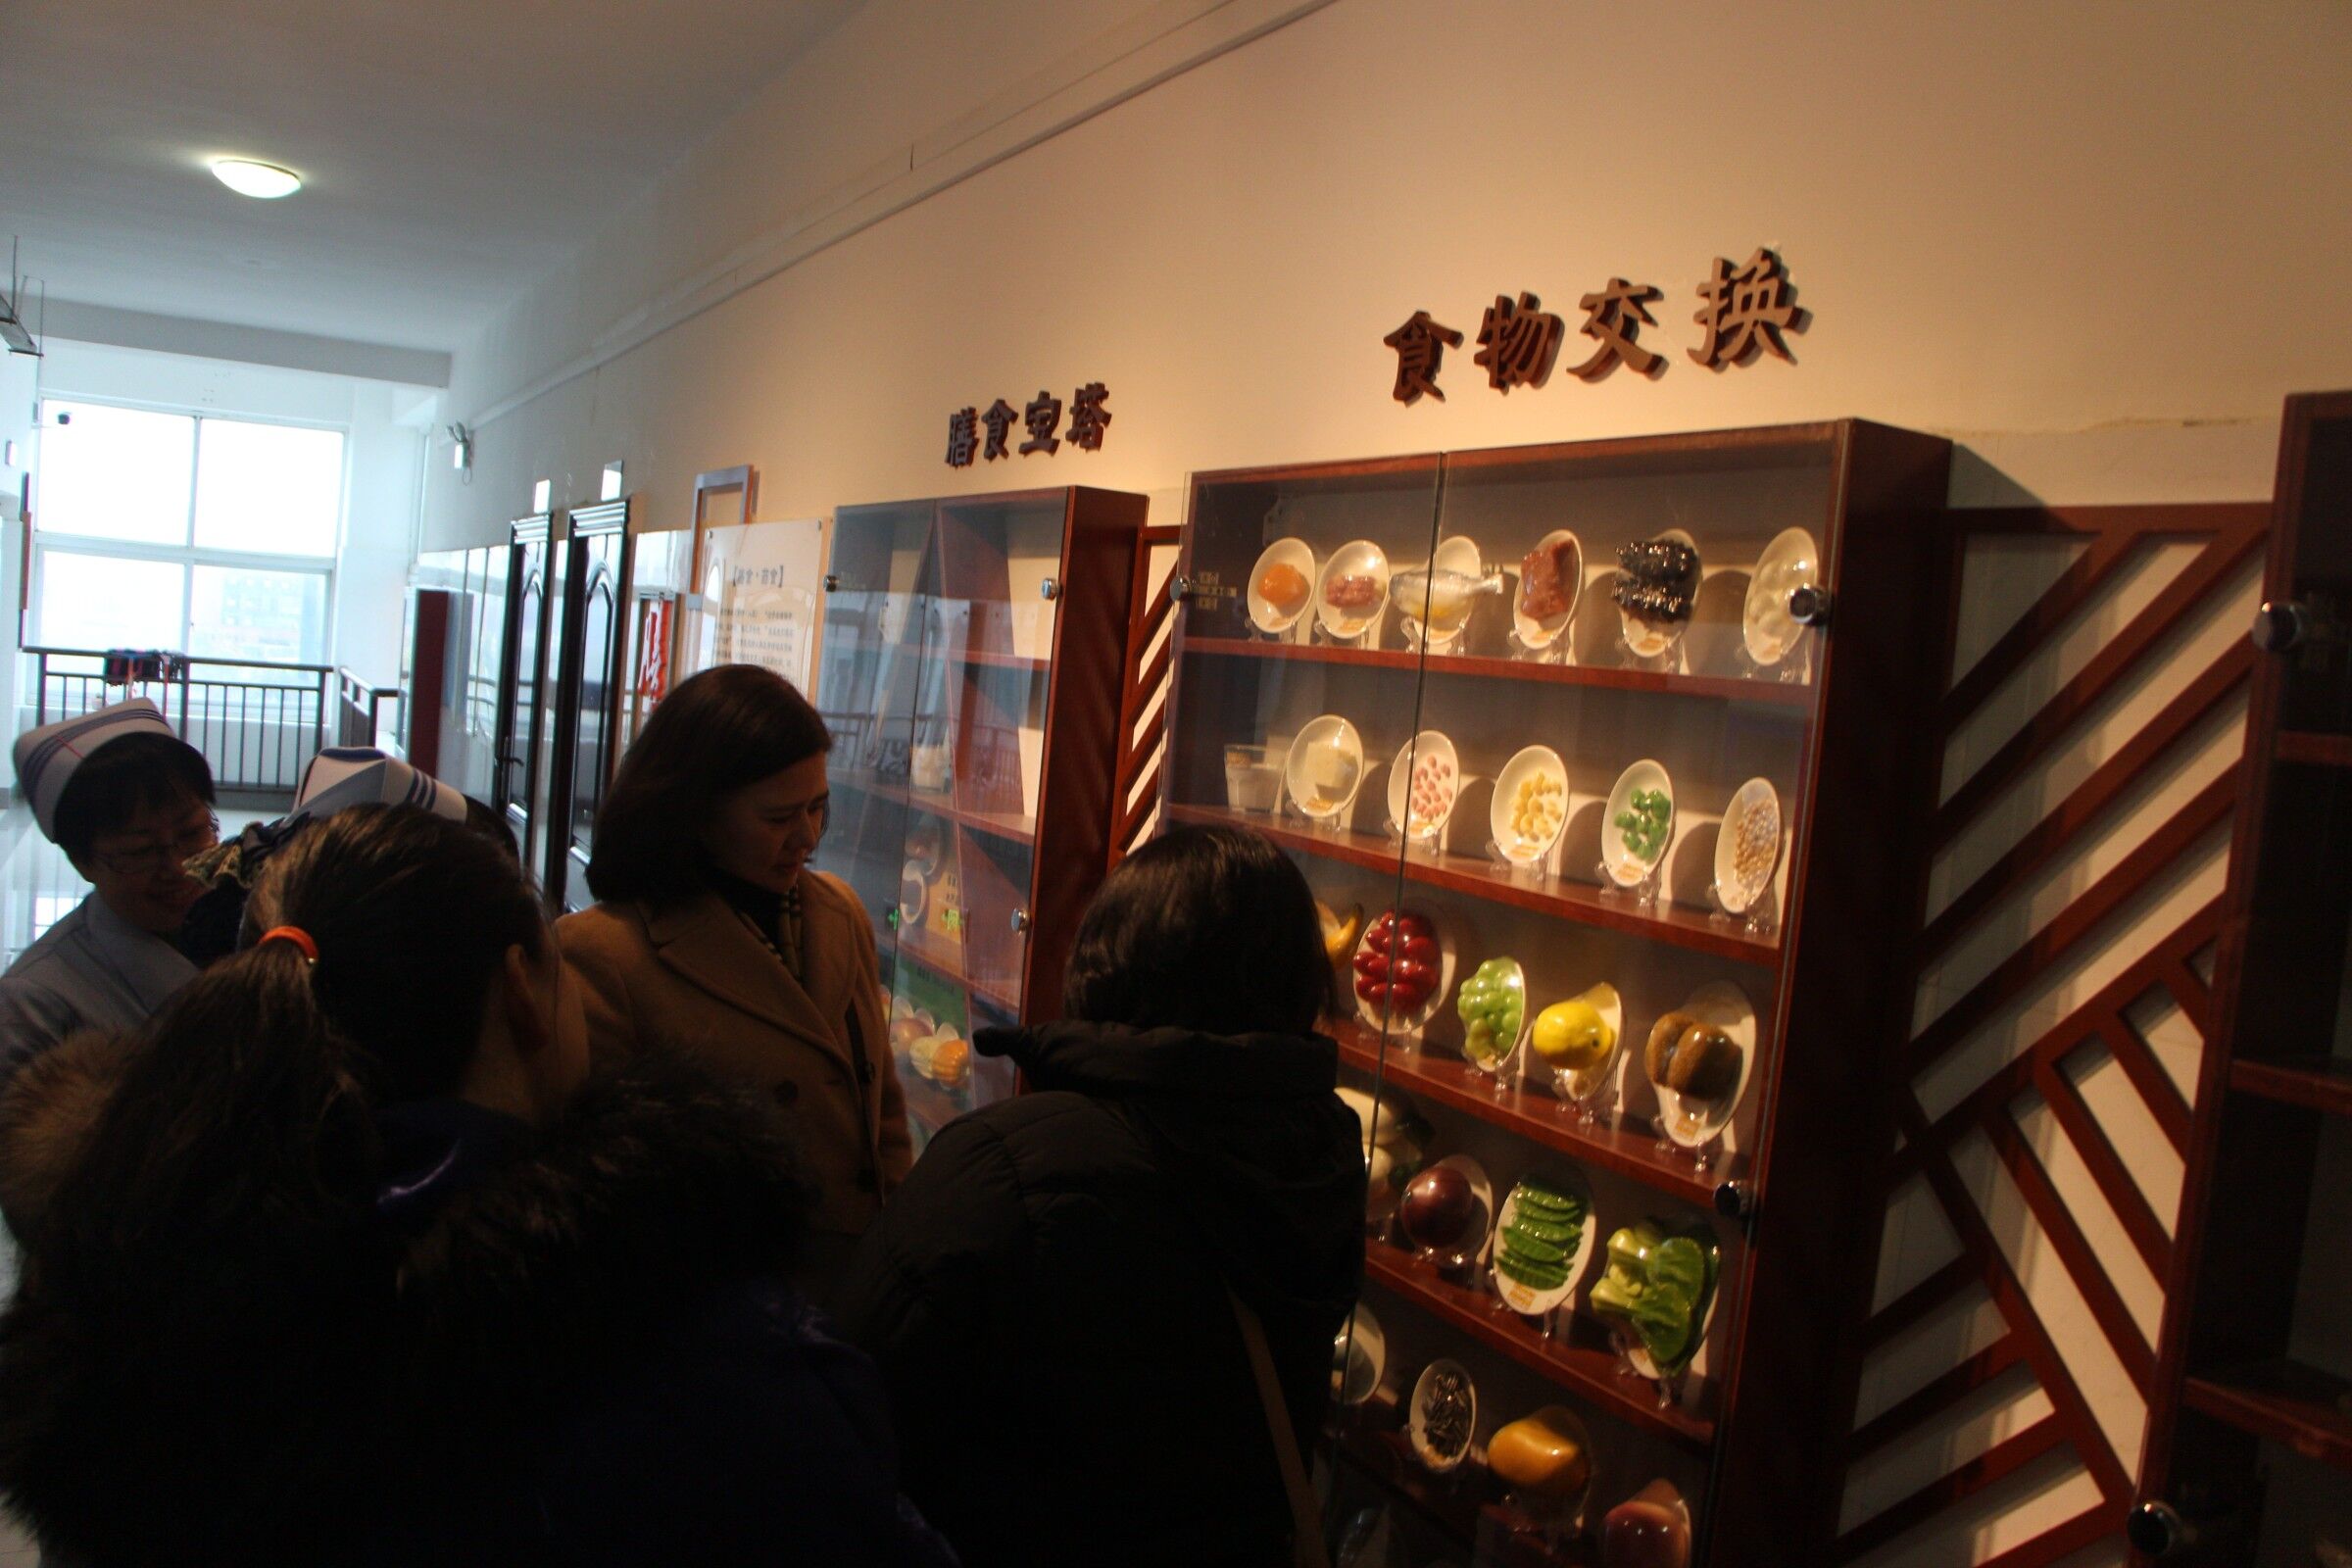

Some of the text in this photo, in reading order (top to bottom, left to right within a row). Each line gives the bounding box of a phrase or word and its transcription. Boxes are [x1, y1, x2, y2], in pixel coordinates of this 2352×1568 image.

[1383, 247, 1812, 407] 食物交换
[945, 382, 1111, 468] 膳食宝塔
